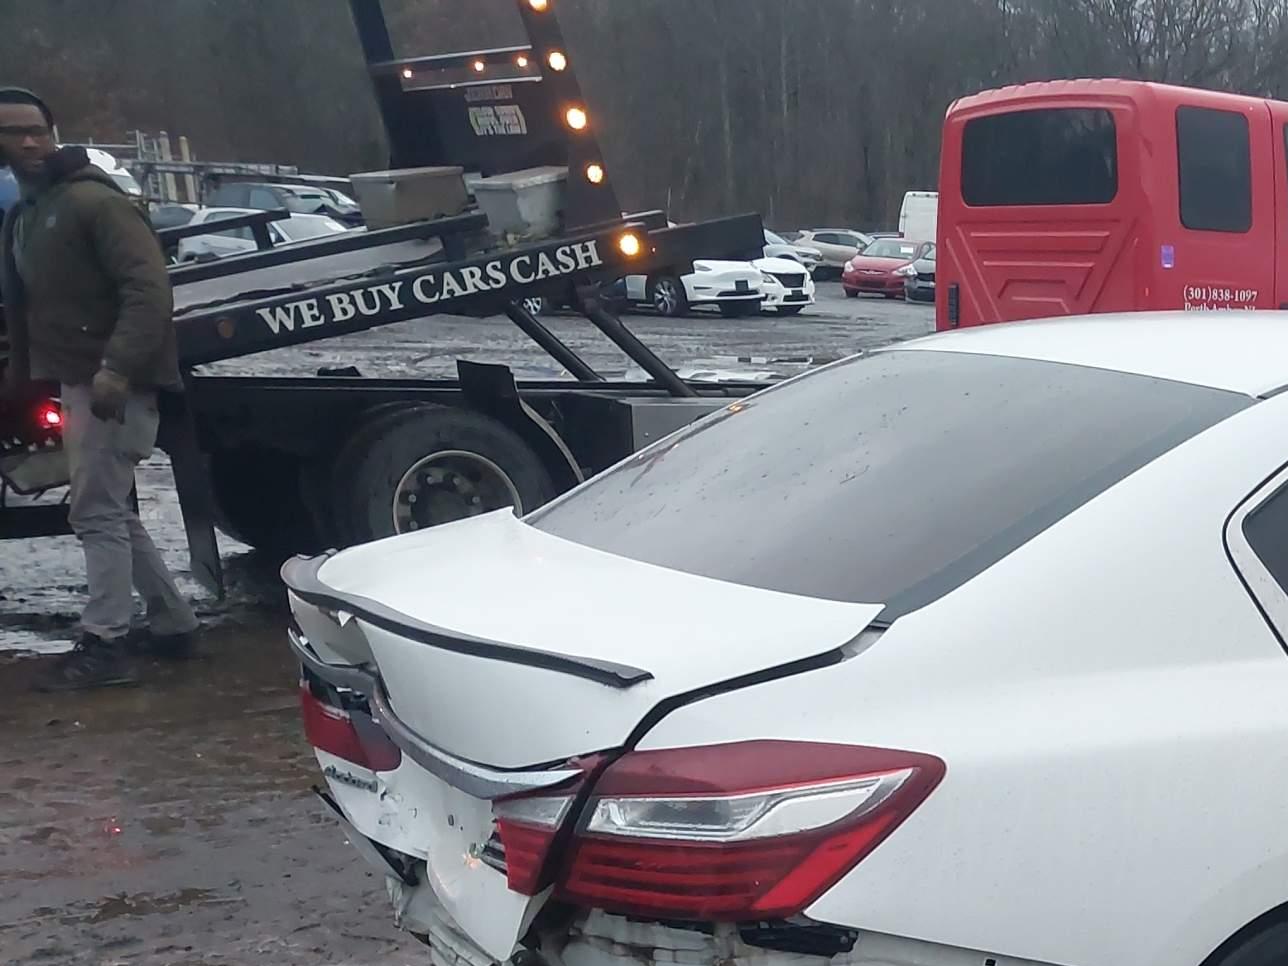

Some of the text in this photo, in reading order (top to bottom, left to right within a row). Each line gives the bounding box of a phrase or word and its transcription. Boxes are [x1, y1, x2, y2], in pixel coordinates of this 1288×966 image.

[256, 240, 603, 335] WE BUY CARS CASH
[1183, 285, 1258, 302] (301)838-1097
